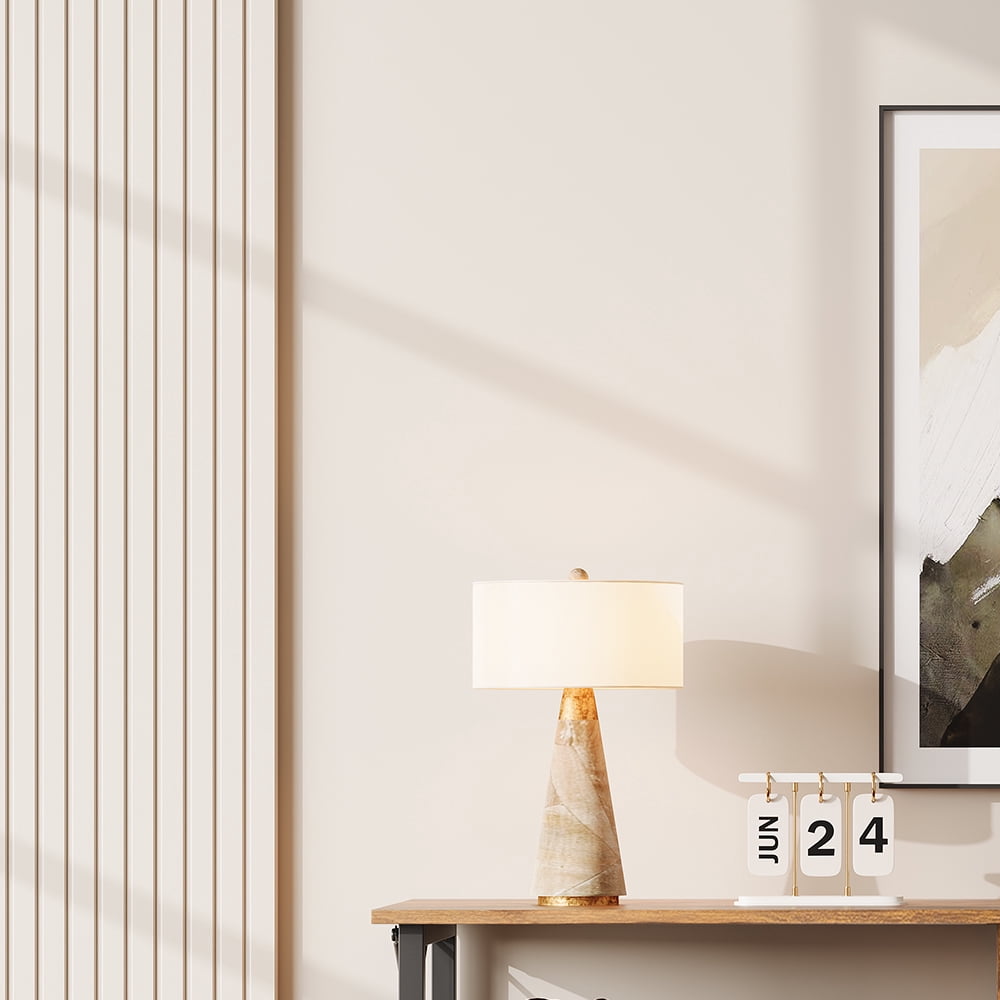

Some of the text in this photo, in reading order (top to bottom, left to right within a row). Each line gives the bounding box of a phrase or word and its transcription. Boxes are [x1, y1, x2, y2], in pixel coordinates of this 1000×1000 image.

[758, 816, 889, 864] JUN 2 4
